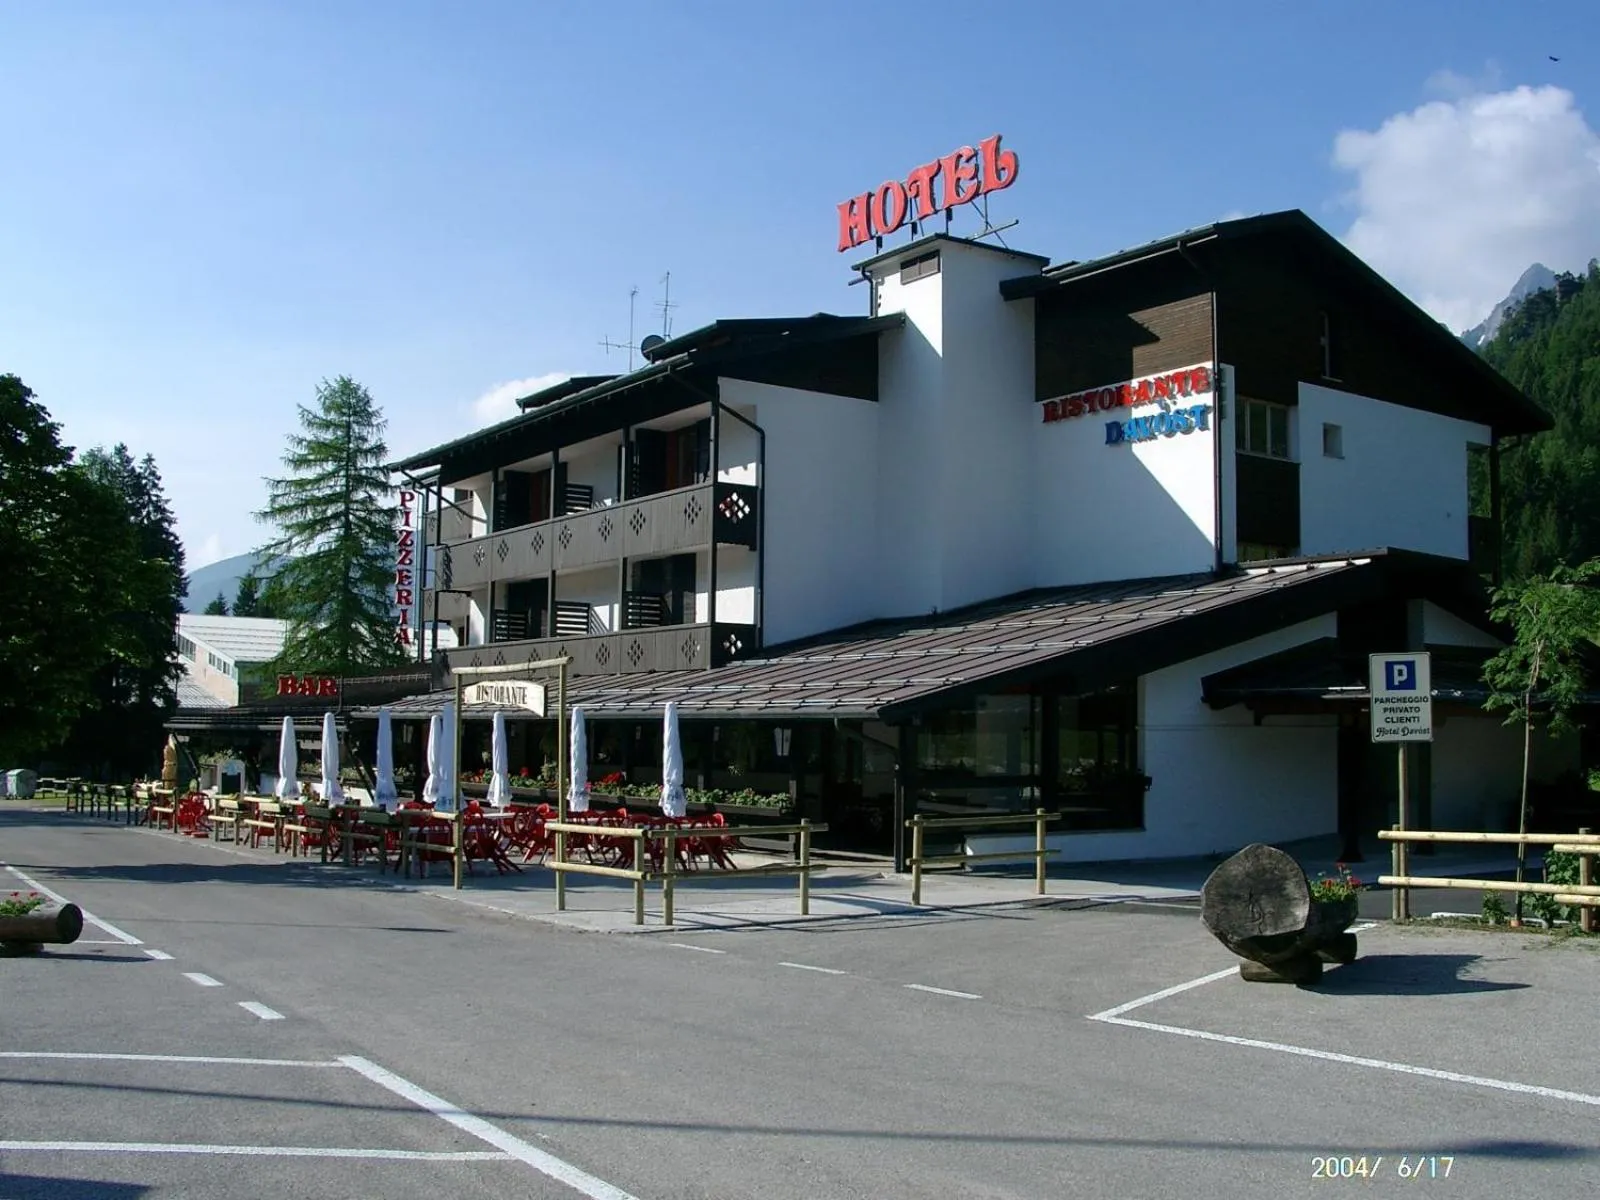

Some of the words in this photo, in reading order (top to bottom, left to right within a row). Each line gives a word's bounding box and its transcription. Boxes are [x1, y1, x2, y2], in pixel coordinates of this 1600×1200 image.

[837, 134, 1019, 252] HOTEL
[1043, 366, 1211, 423] RISTORANTE
[395, 491, 415, 644] PIZZERIA
[276, 673, 337, 695] BAR
[1393, 664, 1408, 685] P
[476, 685, 528, 705] RISTORANTE
[1374, 696, 1429, 704] PARCHEGGIO
[1384, 716, 1420, 724] CLIENTI
[1375, 727, 1400, 738] Hotel
